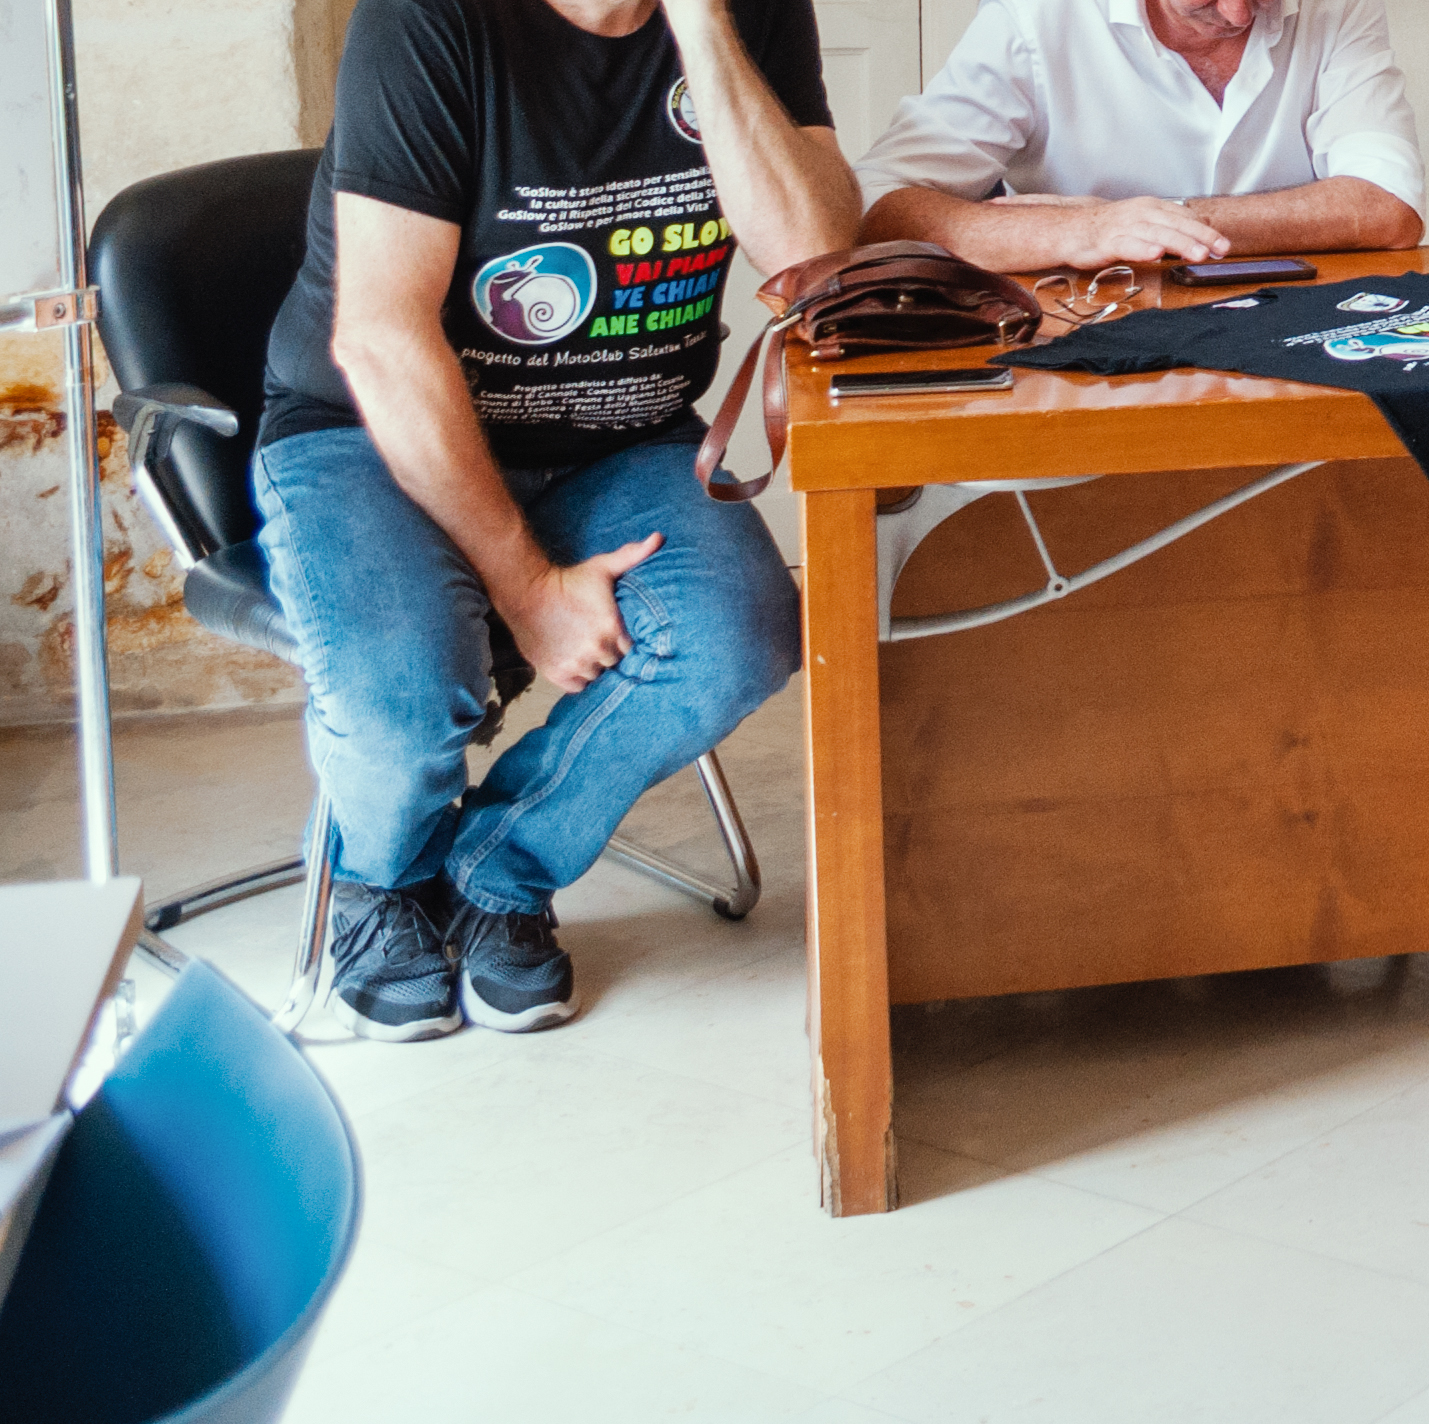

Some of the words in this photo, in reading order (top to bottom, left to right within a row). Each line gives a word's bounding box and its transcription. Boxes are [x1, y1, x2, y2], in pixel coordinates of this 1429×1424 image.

[605, 179, 642, 191] ideato
[643, 175, 662, 187] per
[498, 209, 547, 221] GoSlow
[548, 212, 557, 221] e
[615, 201, 633, 212] del
[634, 195, 675, 208] Codice
[676, 191, 704, 203] della
[530, 198, 543, 209] la
[544, 198, 587, 210] cultura
[588, 193, 614, 206] della
[615, 186, 667, 202] sicurezza
[539, 221, 585, 233] GoSlow
[586, 219, 594, 228] e
[594, 216, 614, 229] per
[615, 209, 652, 222] amore
[654, 205, 684, 217] della
[609, 226, 654, 256] GO
[615, 260, 663, 286] VAI
[588, 313, 640, 339] ANE
[645, 293, 715, 332] CHIANU
[461, 347, 522, 365] progetto
[527, 352, 549, 367] del
[554, 348, 624, 368] MotoClub
[683, 330, 708, 348] Tour
[473, 399, 509, 407] omune
[480, 389, 522, 400] Comune
